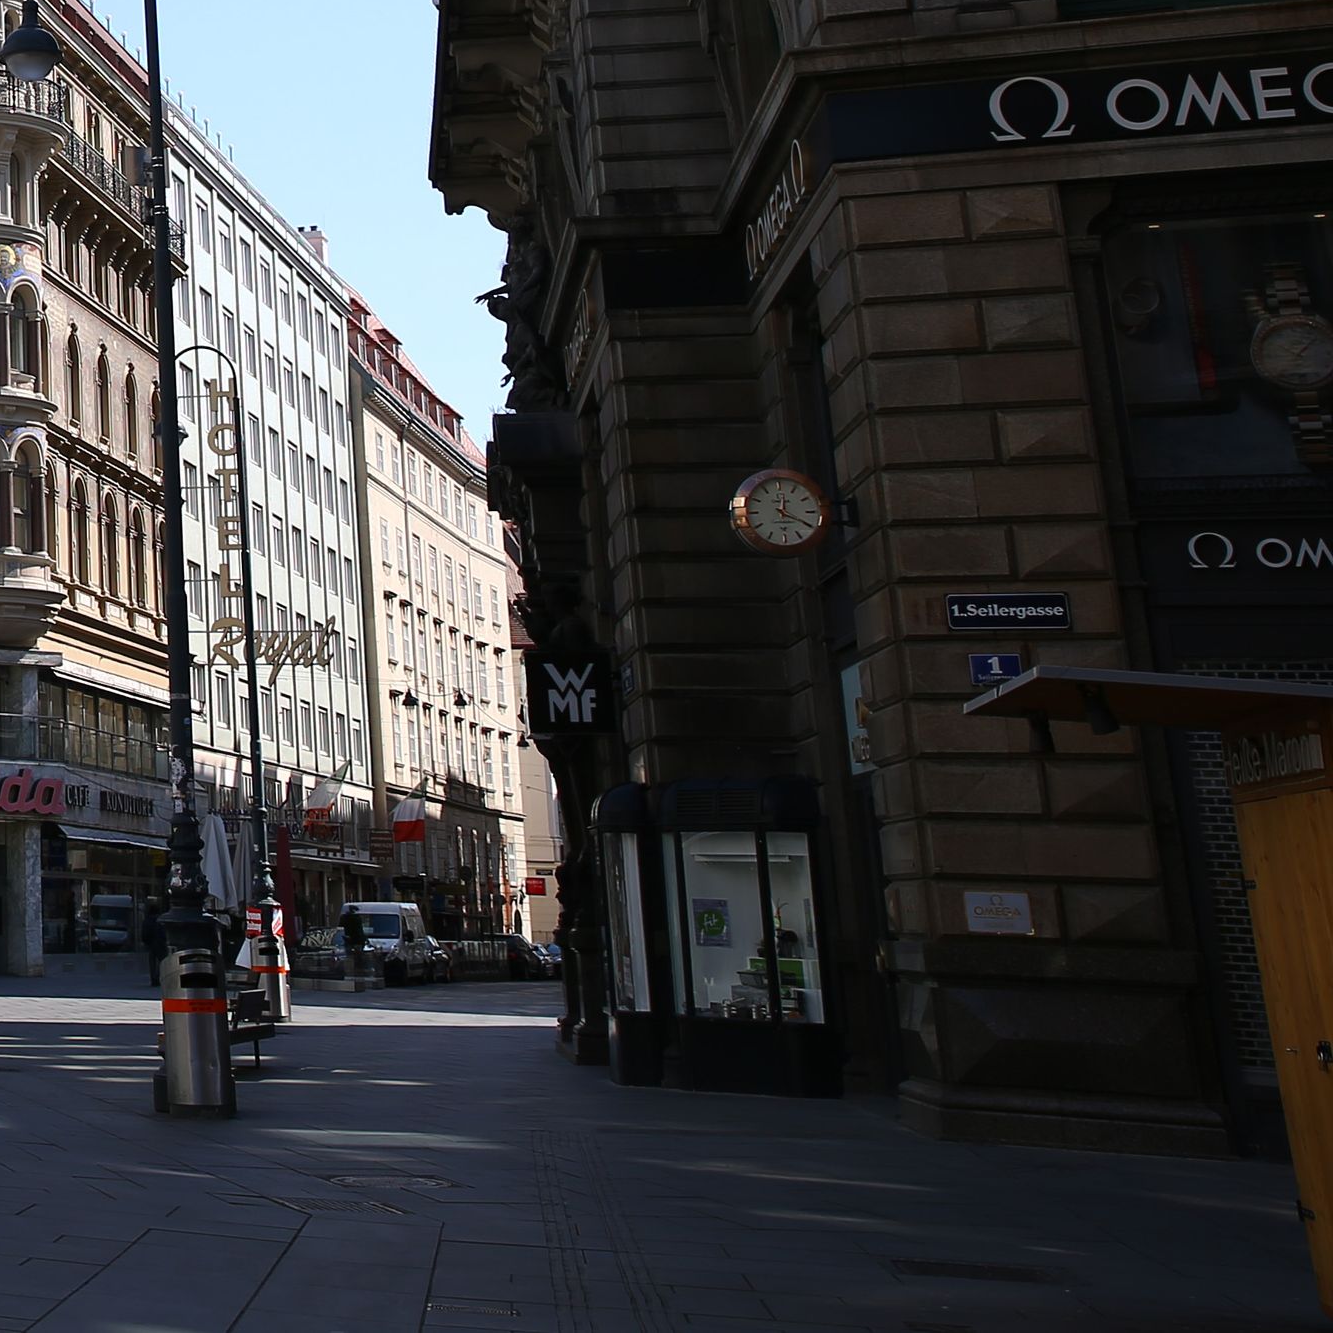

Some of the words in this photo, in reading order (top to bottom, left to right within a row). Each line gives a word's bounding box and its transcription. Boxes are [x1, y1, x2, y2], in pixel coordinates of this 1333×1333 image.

[757, 170, 793, 261] OMEGA
[207, 377, 244, 599] HOTEL
[987, 656, 1003, 674] 1
[973, 906, 1022, 917] OMEGA
